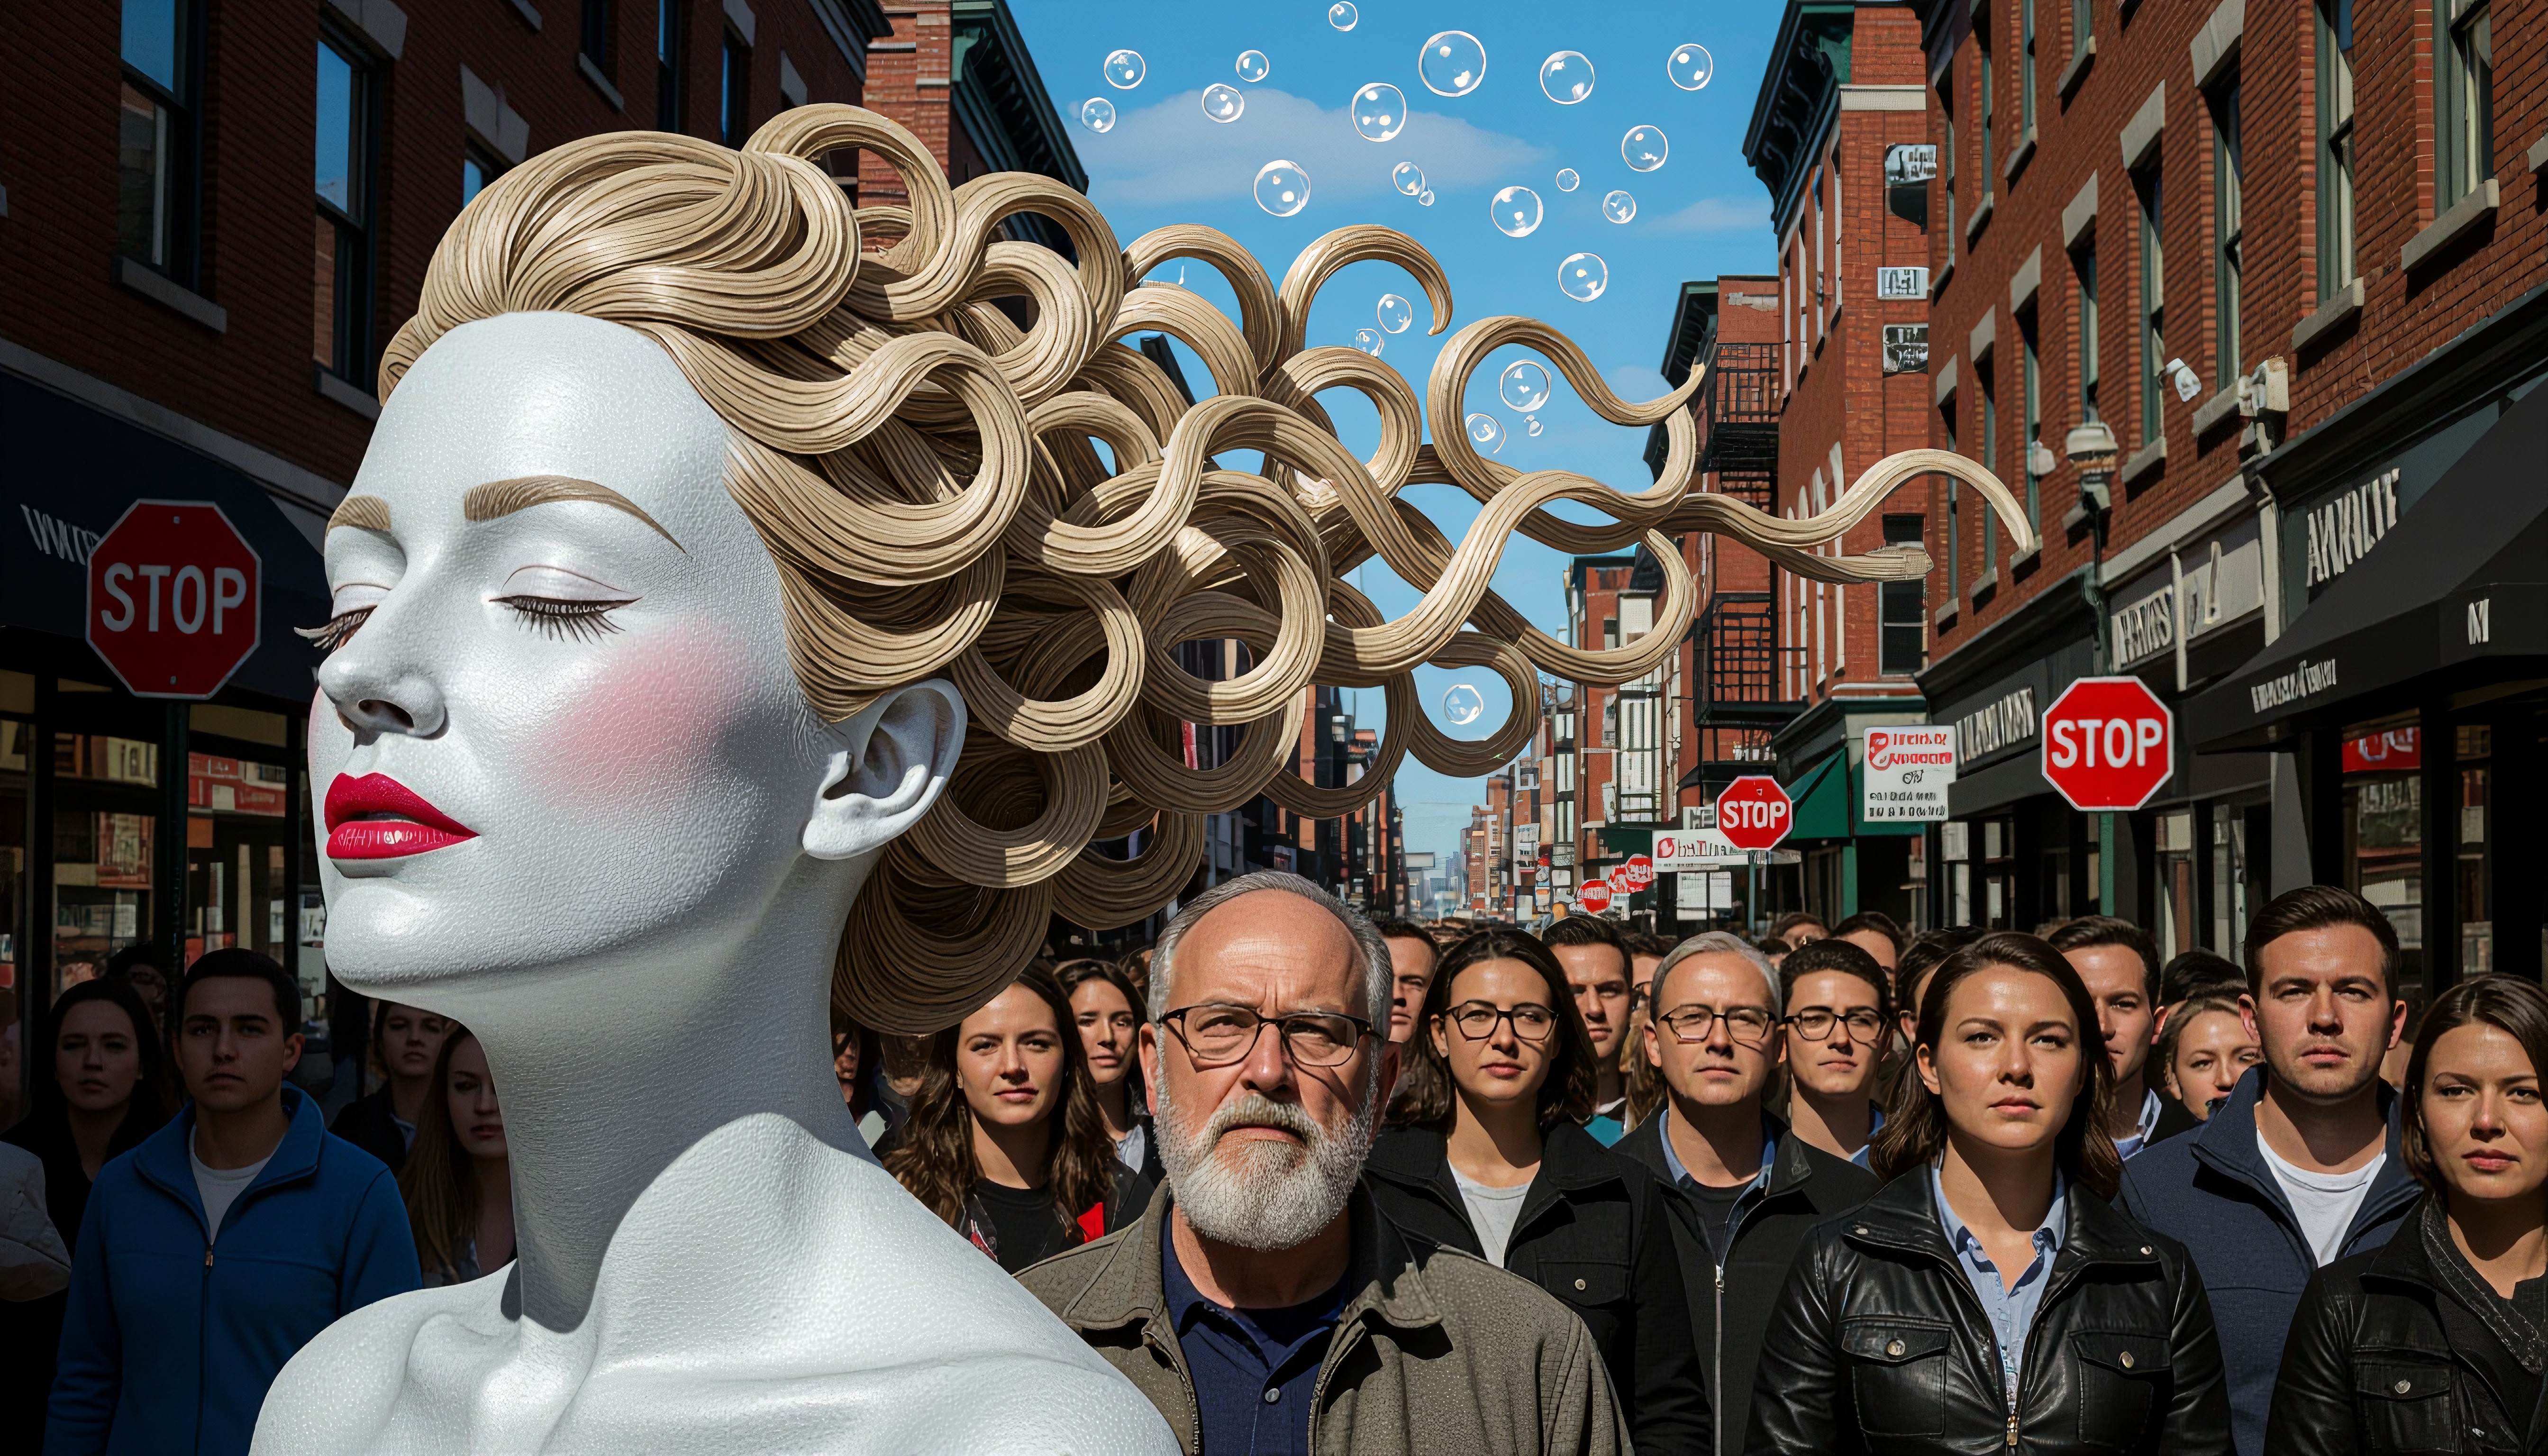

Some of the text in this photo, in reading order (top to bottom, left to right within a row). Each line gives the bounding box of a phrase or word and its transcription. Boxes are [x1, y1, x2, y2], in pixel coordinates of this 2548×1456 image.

[101, 562, 246, 635] STOP
[2051, 718, 2164, 768] STOP
[1722, 800, 1787, 829] STOP
